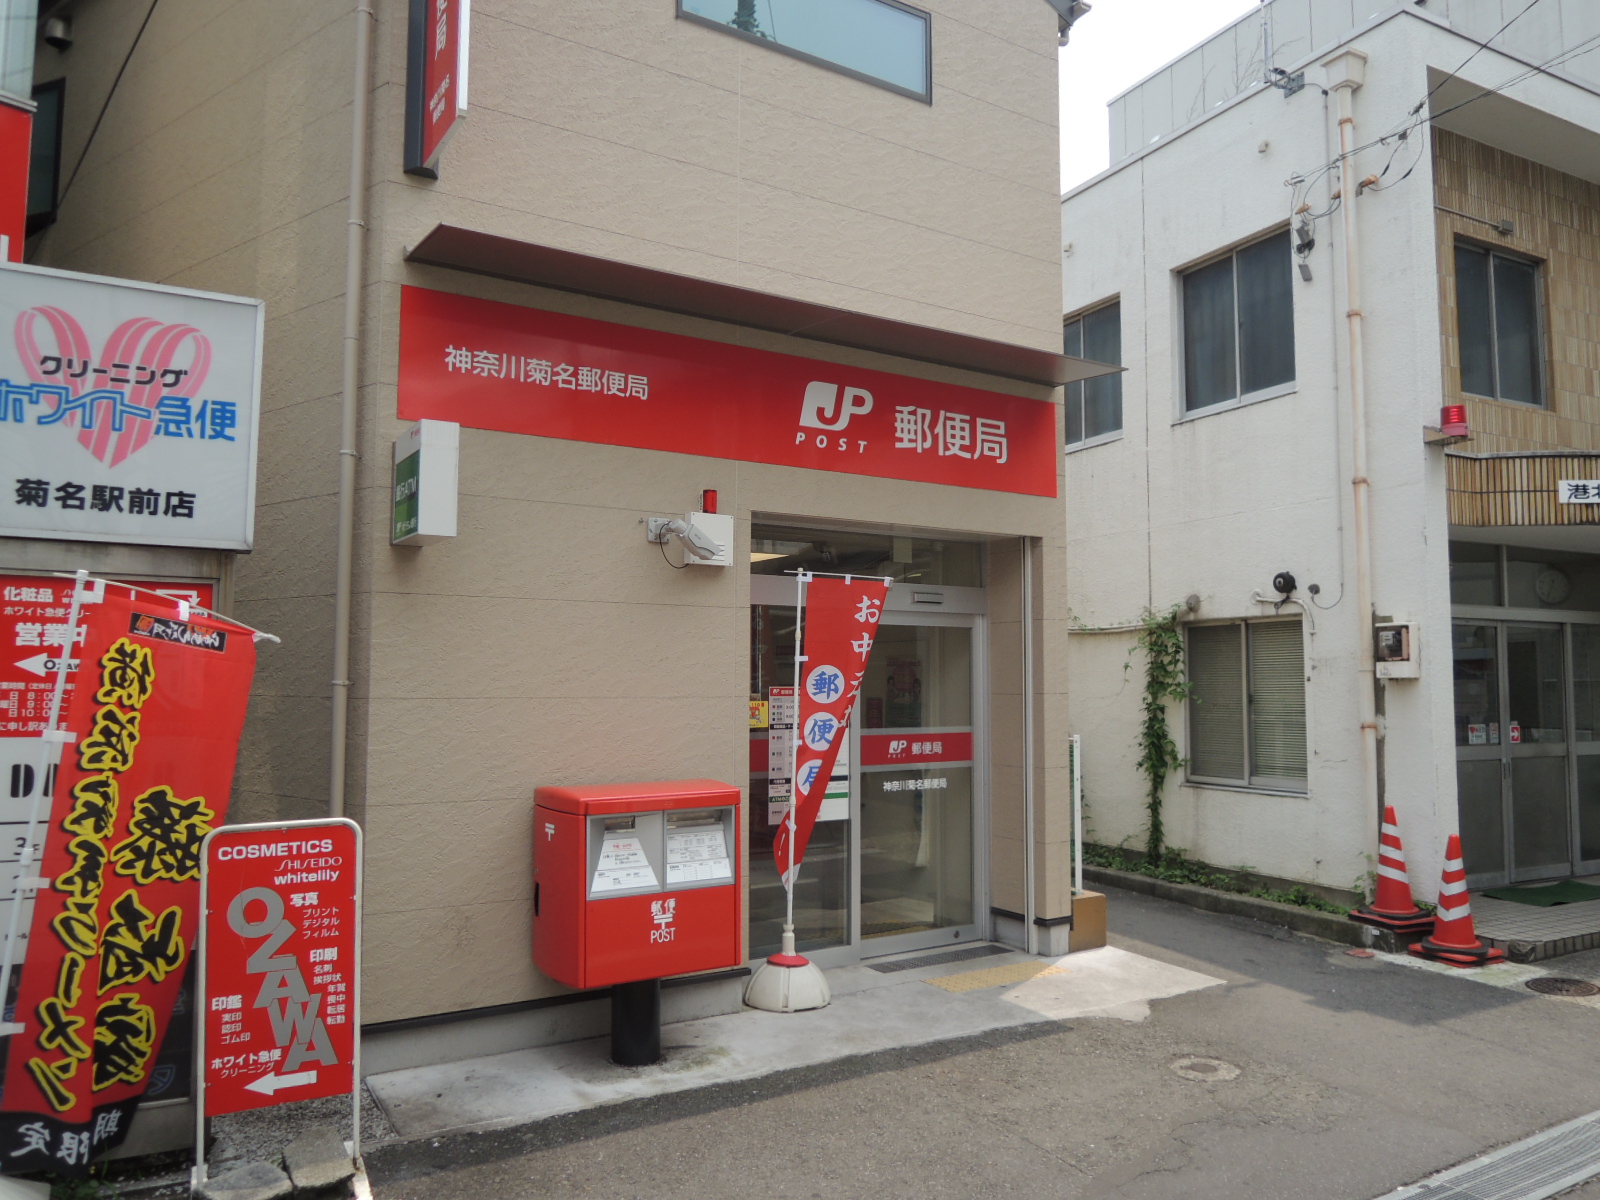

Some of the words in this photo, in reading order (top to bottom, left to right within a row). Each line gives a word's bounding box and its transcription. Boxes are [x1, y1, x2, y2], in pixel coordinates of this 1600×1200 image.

[40, 355, 188, 388] クリーニング
[444, 345, 649, 400] 神奈川菊名郵便局
[894, 405, 1008, 464] 郵便局
[795, 432, 868, 454] POST
[15, 478, 196, 518] 菊名駅前店
[4, 586, 53, 602] 化粧品
[912, 742, 942, 755] 郵便局
[883, 778, 947, 792] 神奈川菊名郵便局
[218, 839, 333, 860] COSMETICS
[274, 856, 343, 871] SHISEIDO
[274, 869, 340, 885] whitelily
[290, 892, 319, 906] 写真
[303, 906, 340, 918] プリント
[651, 898, 676, 916] 郵便
[303, 917, 340, 929] デジタル
[303, 928, 340, 940] フィルム
[651, 928, 676, 943] POST
[310, 947, 338, 962] 印刷
[313, 964, 333, 974] 名刺
[226, 886, 339, 1073] OZAWA
[313, 973, 342, 985] 挨拶状
[327, 983, 346, 993] 年賀
[211, 994, 243, 1011] 印鑑
[221, 1012, 242, 1023] 実印
[221, 1023, 242, 1034] 認印
[220, 1032, 251, 1045] ゴム印
[211, 1049, 282, 1069] ホワイト急便
[220, 1061, 275, 1078] クリーニング
